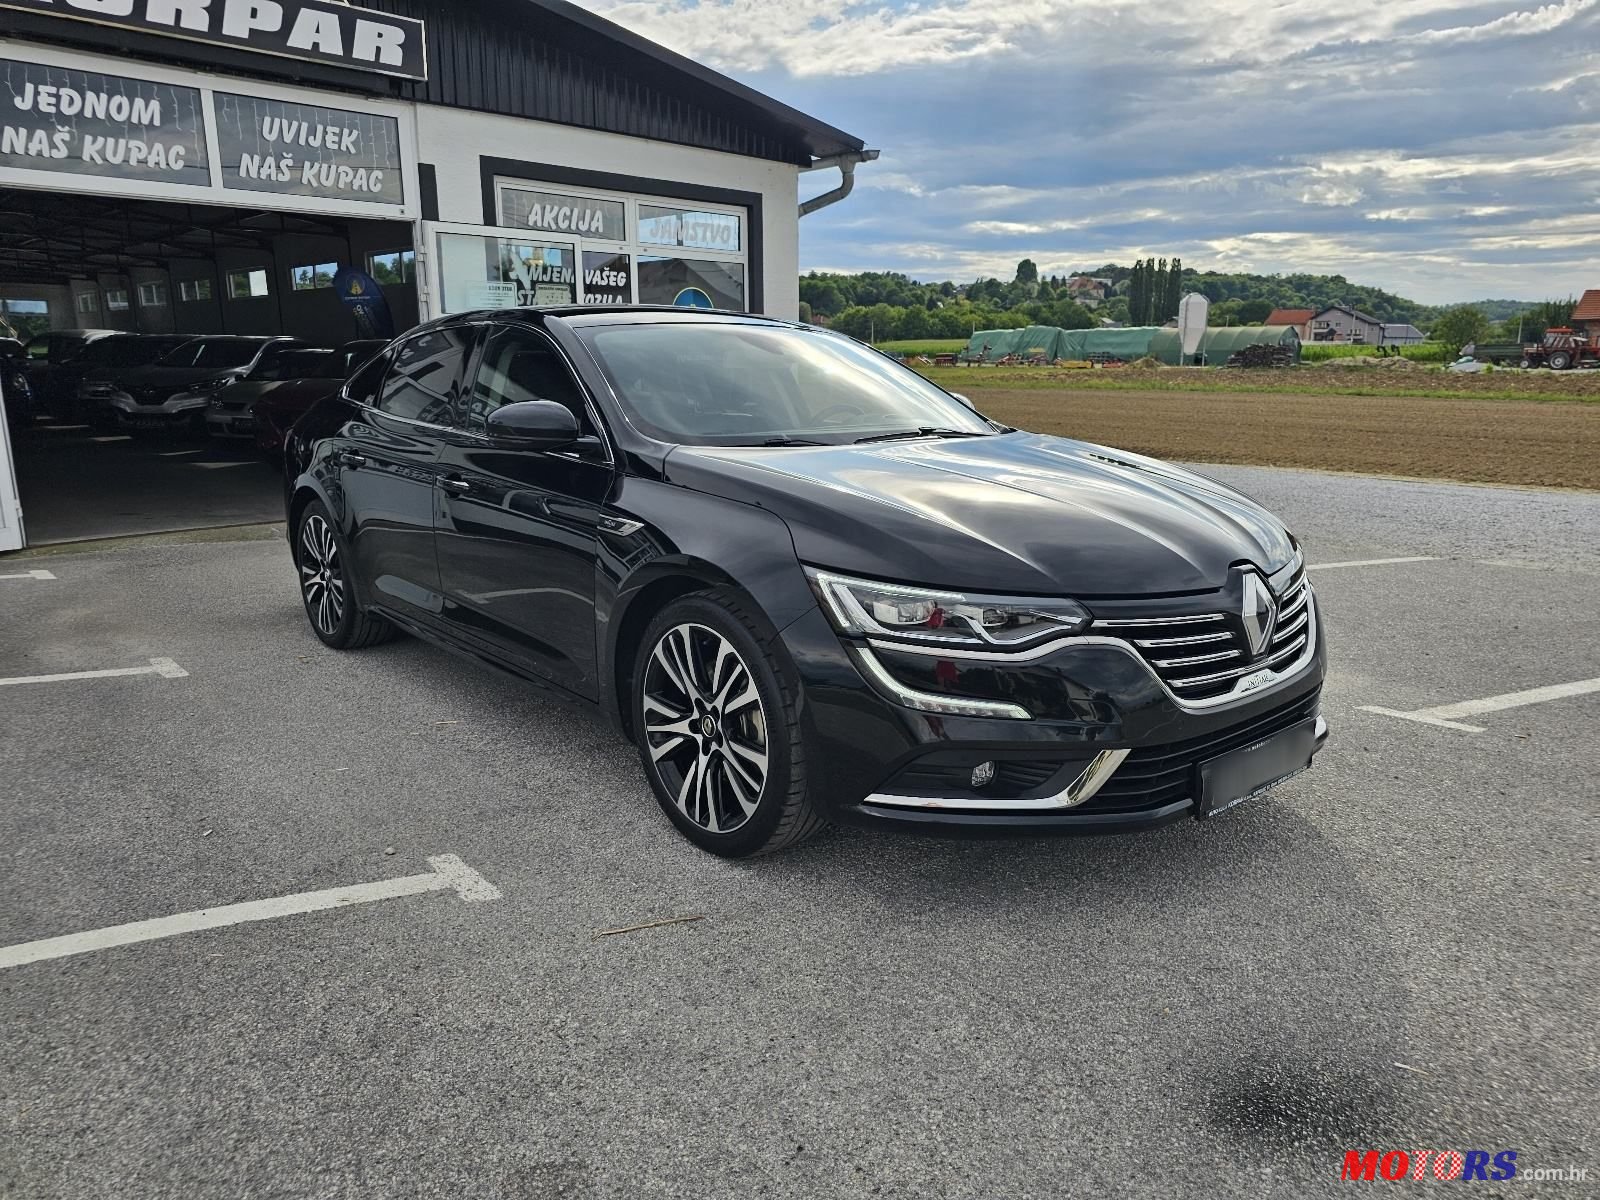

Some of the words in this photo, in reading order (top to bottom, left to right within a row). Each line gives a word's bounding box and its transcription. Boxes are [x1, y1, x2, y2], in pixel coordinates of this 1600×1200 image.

[14, 82, 161, 127] JEDNOM
[2, 126, 71, 160] NAŠ
[82, 134, 186, 171] KUPAC
[262, 116, 359, 154] UVIJEK
[239, 153, 295, 182] NAŠ
[302, 161, 383, 193] KUPAC
[528, 203, 603, 233] AKCIJA
[650, 219, 731, 244] JAMSTVO
[585, 266, 627, 287] VAŠEG
